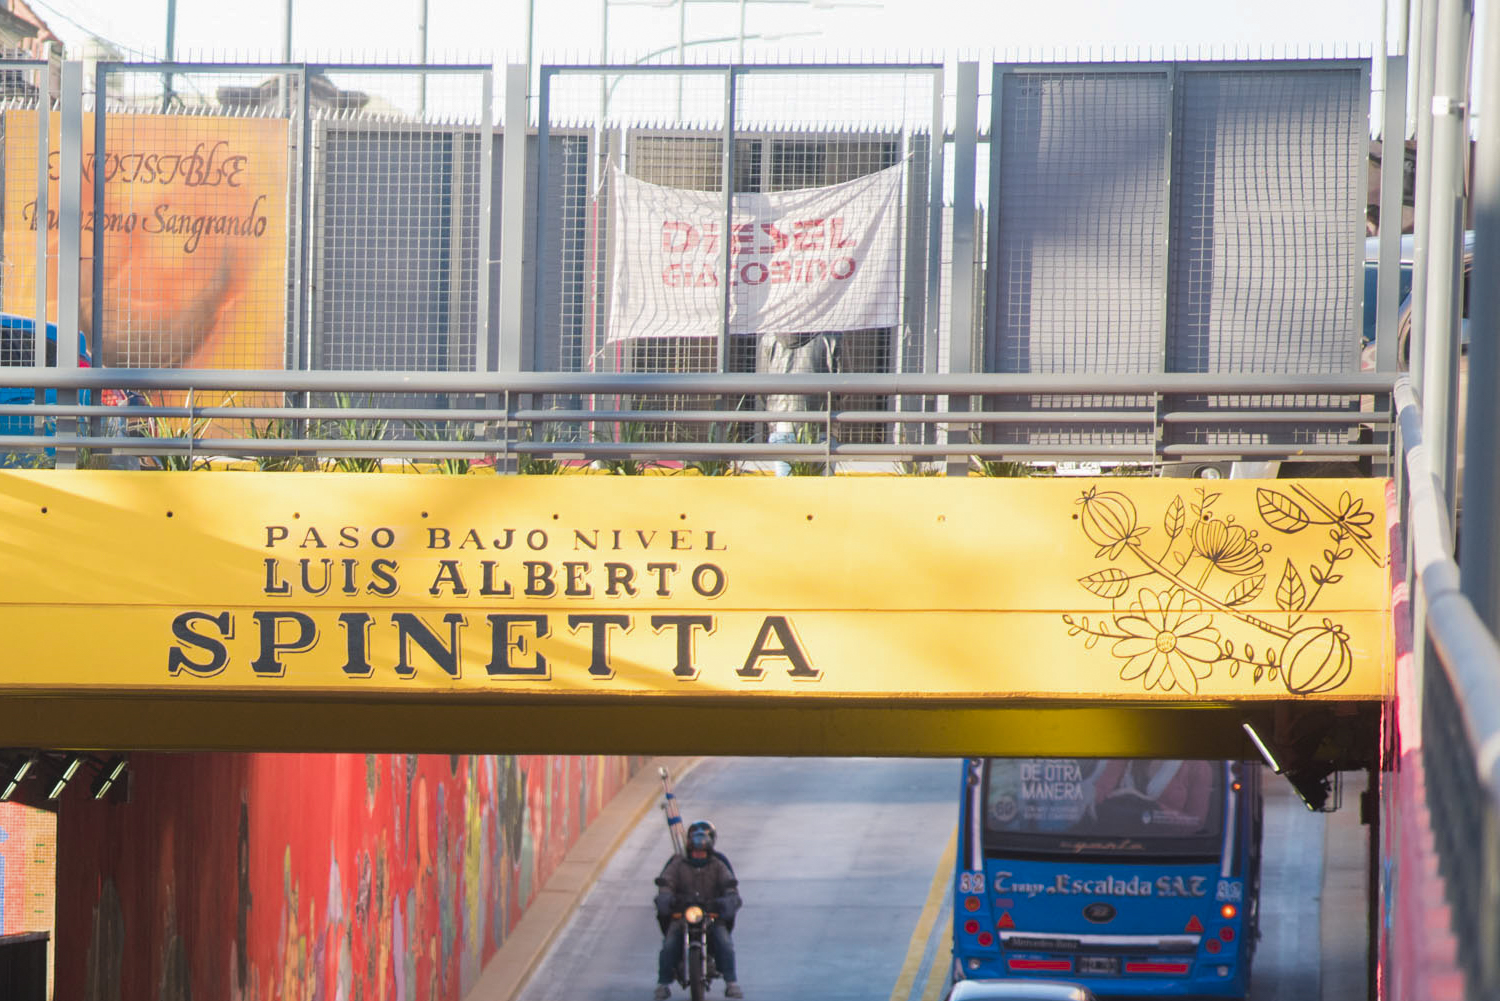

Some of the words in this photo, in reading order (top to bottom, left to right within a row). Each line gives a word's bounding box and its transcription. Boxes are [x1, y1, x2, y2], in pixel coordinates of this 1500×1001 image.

[142, 195, 267, 254] Sangrando
[662, 257, 856, 287] GIAOBINO
[265, 526, 396, 549] PASO
[427, 528, 550, 550] BAJO
[573, 529, 728, 551] NIVEL
[263, 557, 400, 598] LUIS
[428, 559, 729, 600] ALBERTO
[167, 610, 825, 681] SPINETTA
[1021, 763, 1040, 780] DE
[1045, 764, 1083, 781] OTRA
[1021, 782, 1084, 800] MANERA
[960, 872, 985, 894] 32
[1054, 873, 1152, 896] Escalada
